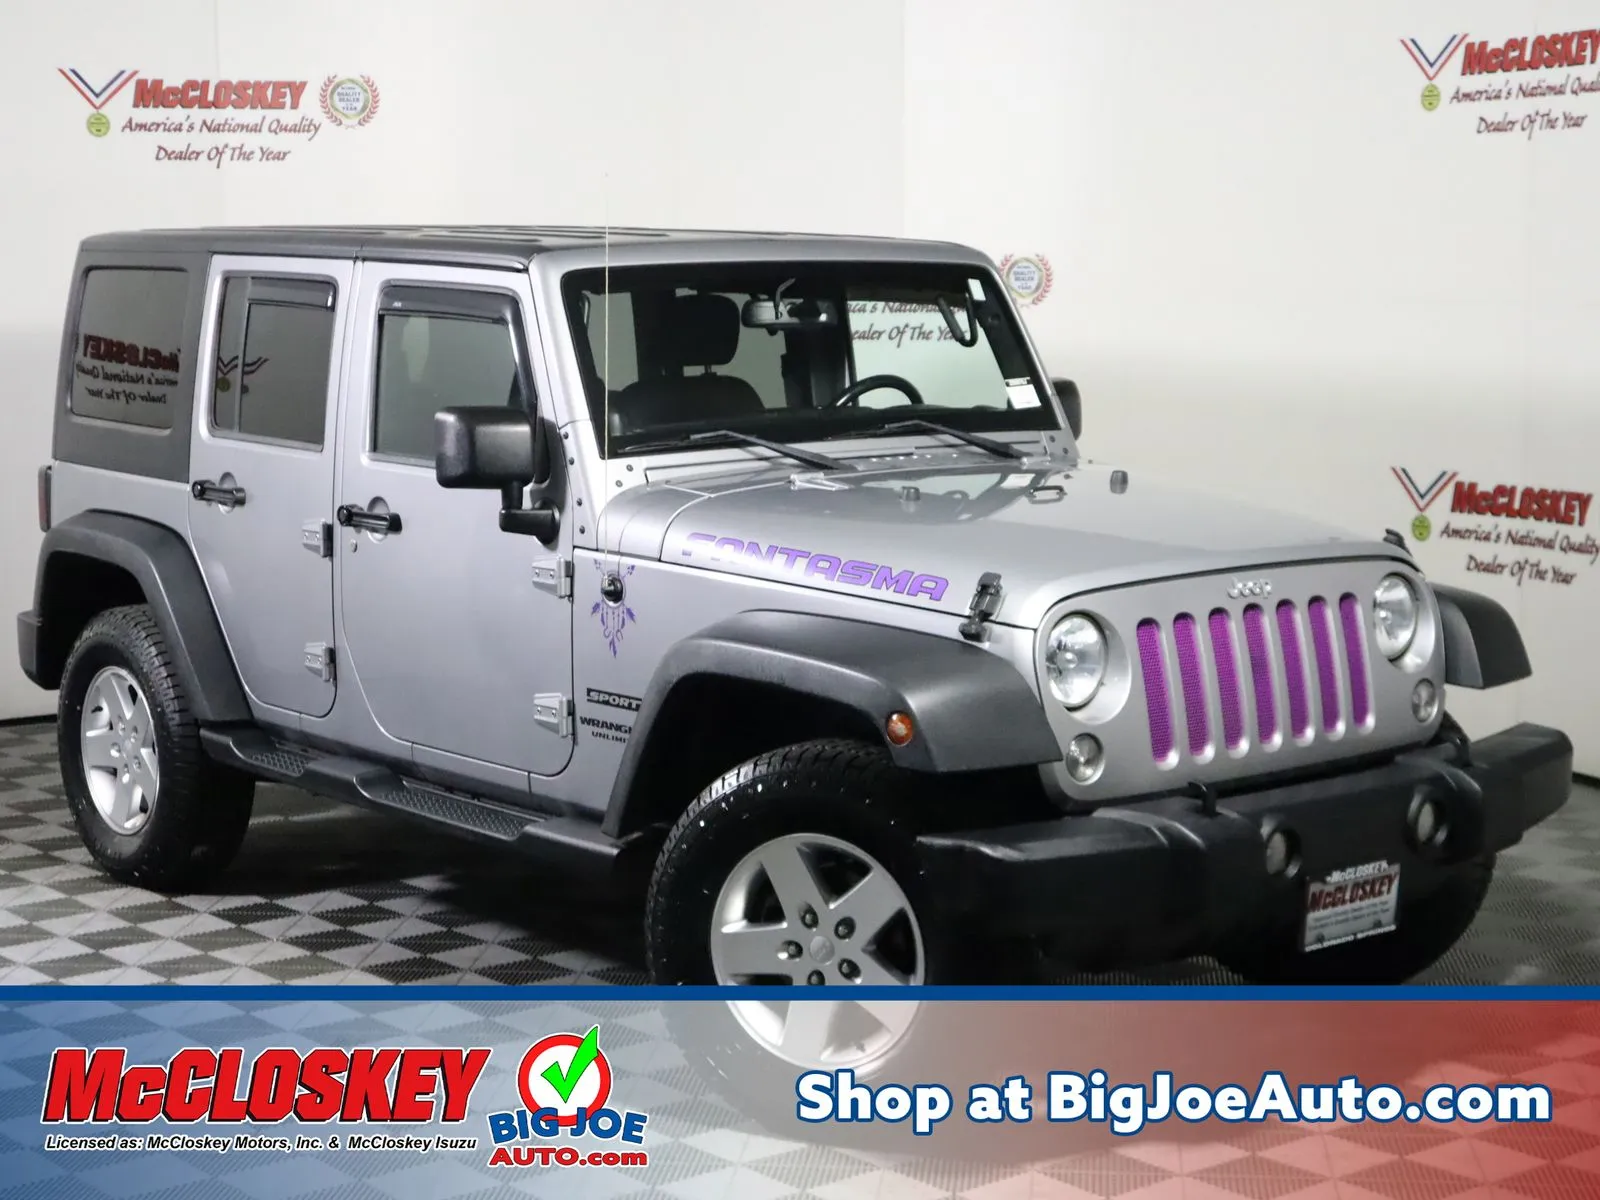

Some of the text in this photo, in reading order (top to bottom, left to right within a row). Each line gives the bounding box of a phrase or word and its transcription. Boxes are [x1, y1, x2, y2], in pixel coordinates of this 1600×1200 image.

[1461, 29, 1600, 76] McCLOSKEY
[132, 78, 307, 109] McCLOSKEY
[1449, 80, 1513, 104] America's
[1516, 73, 1570, 100] National
[1571, 70, 1600, 96] Qual
[121, 114, 195, 133] America's
[199, 117, 263, 134] National
[267, 117, 322, 142] Quality
[1476, 109, 1588, 141] Dealer Of The Year
[155, 143, 291, 169] Dealer Of The Year
[852, 323, 884, 341] ealer
[888, 322, 910, 349] Of
[909, 323, 934, 341] The
[1451, 481, 1593, 527] McCLOSKEY
[1440, 521, 1502, 544] America's
[1504, 531, 1558, 550] National
[1559, 534, 1600, 565] Quality
[1466, 554, 1577, 586] Dealer Of The Year
[587, 690, 642, 710] SPORT
[591, 731, 627, 744] UNLIMI
